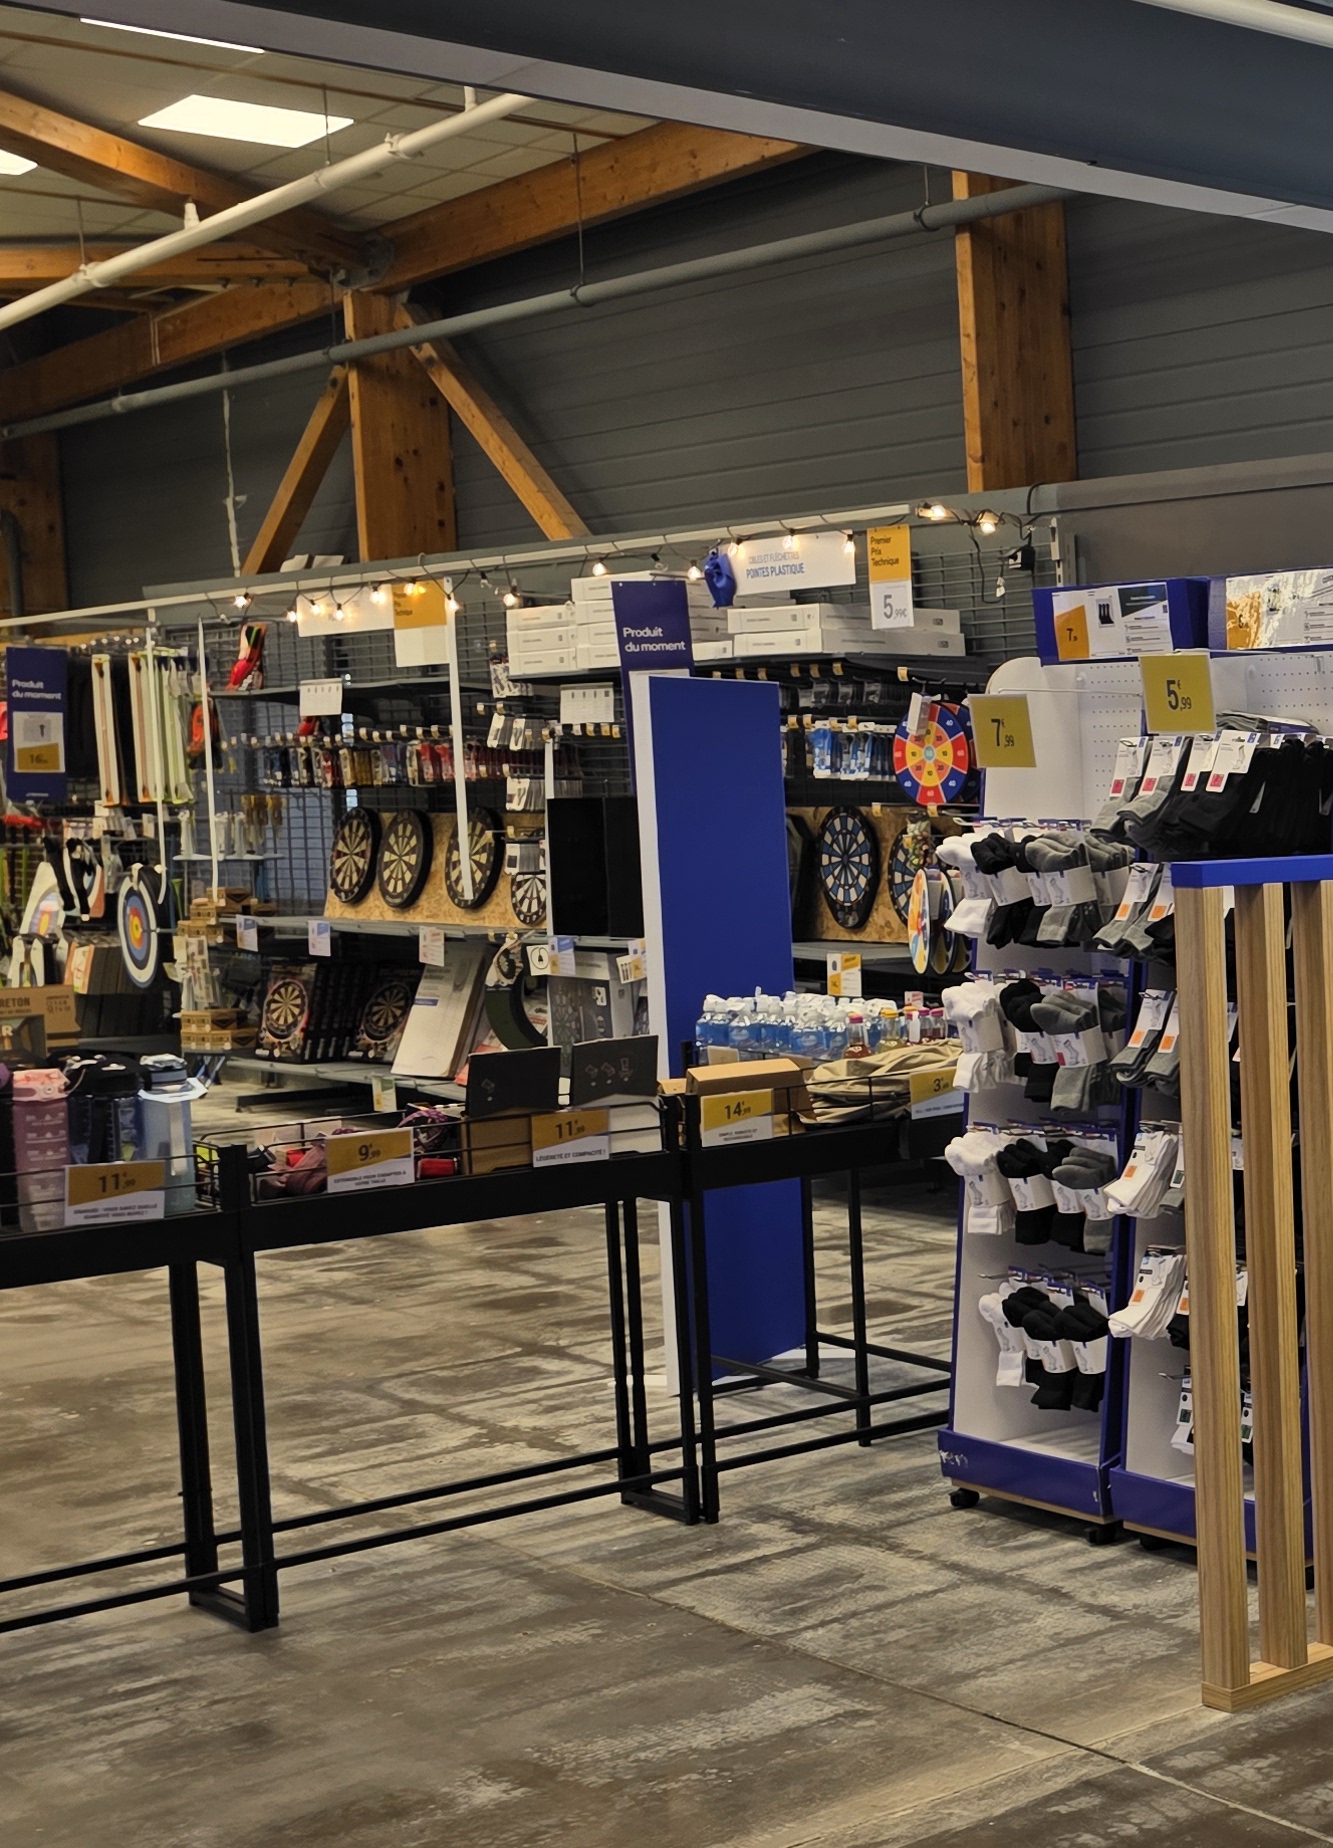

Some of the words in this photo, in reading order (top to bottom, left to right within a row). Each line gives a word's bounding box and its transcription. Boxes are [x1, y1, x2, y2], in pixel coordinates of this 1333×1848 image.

[870, 535, 892, 545] Premier
[871, 547, 882, 555] Prix
[871, 557, 900, 567] Technique
[746, 566, 770, 579] POINTES
[770, 562, 805, 577] PLASTIQUE
[622, 626, 664, 637] Produit
[624, 641, 640, 652] du
[640, 641, 687, 652] moment
[12, 679, 44, 689] Produit
